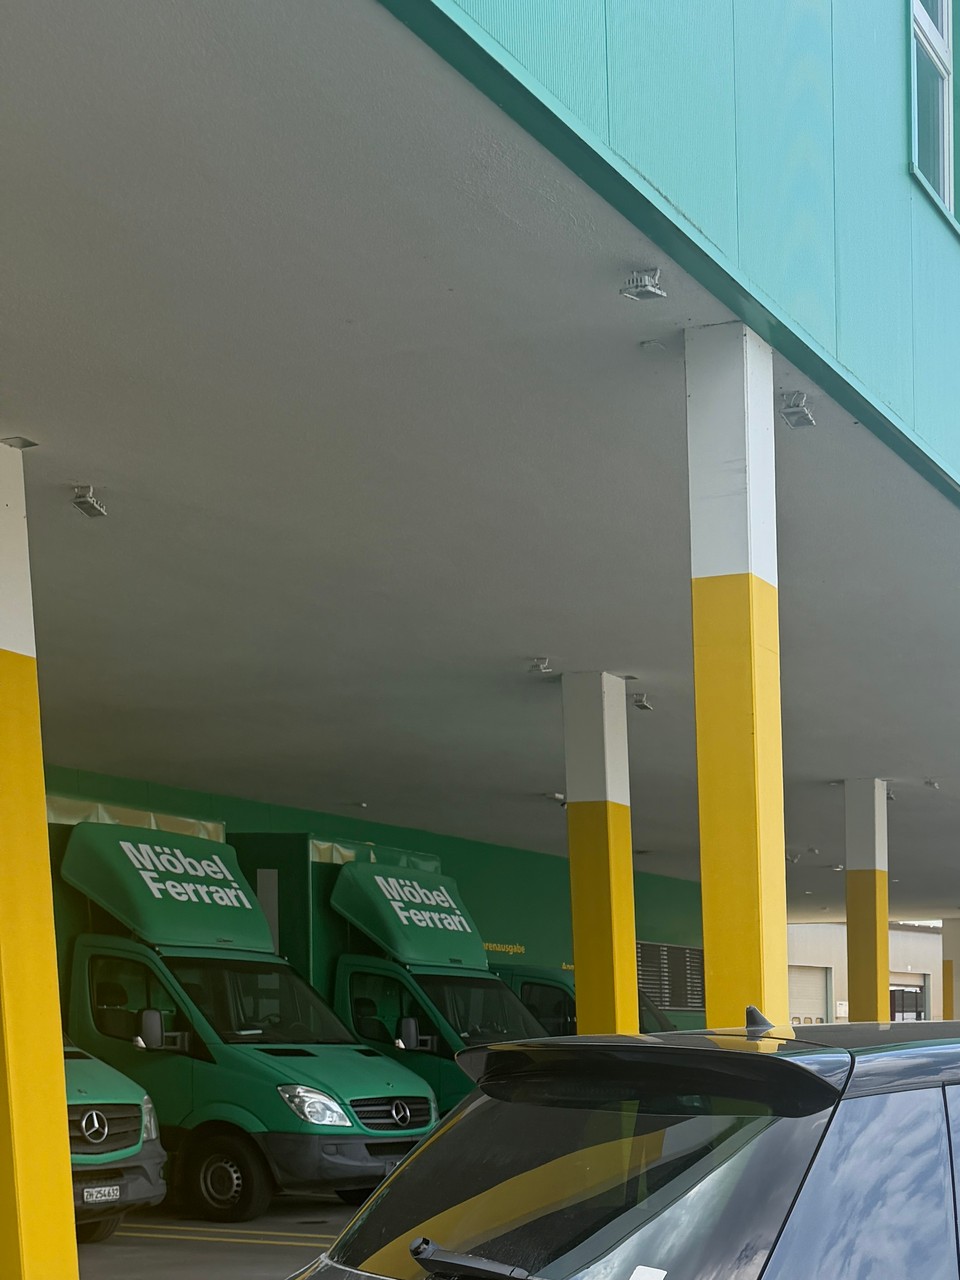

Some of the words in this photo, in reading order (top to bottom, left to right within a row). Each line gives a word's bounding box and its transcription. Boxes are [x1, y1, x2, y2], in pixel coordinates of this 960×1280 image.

[119, 840, 234, 881] Möbel
[139, 870, 253, 910] Ferrari
[374, 875, 458, 909] Möbel
[390, 901, 473, 933] Ferrari
